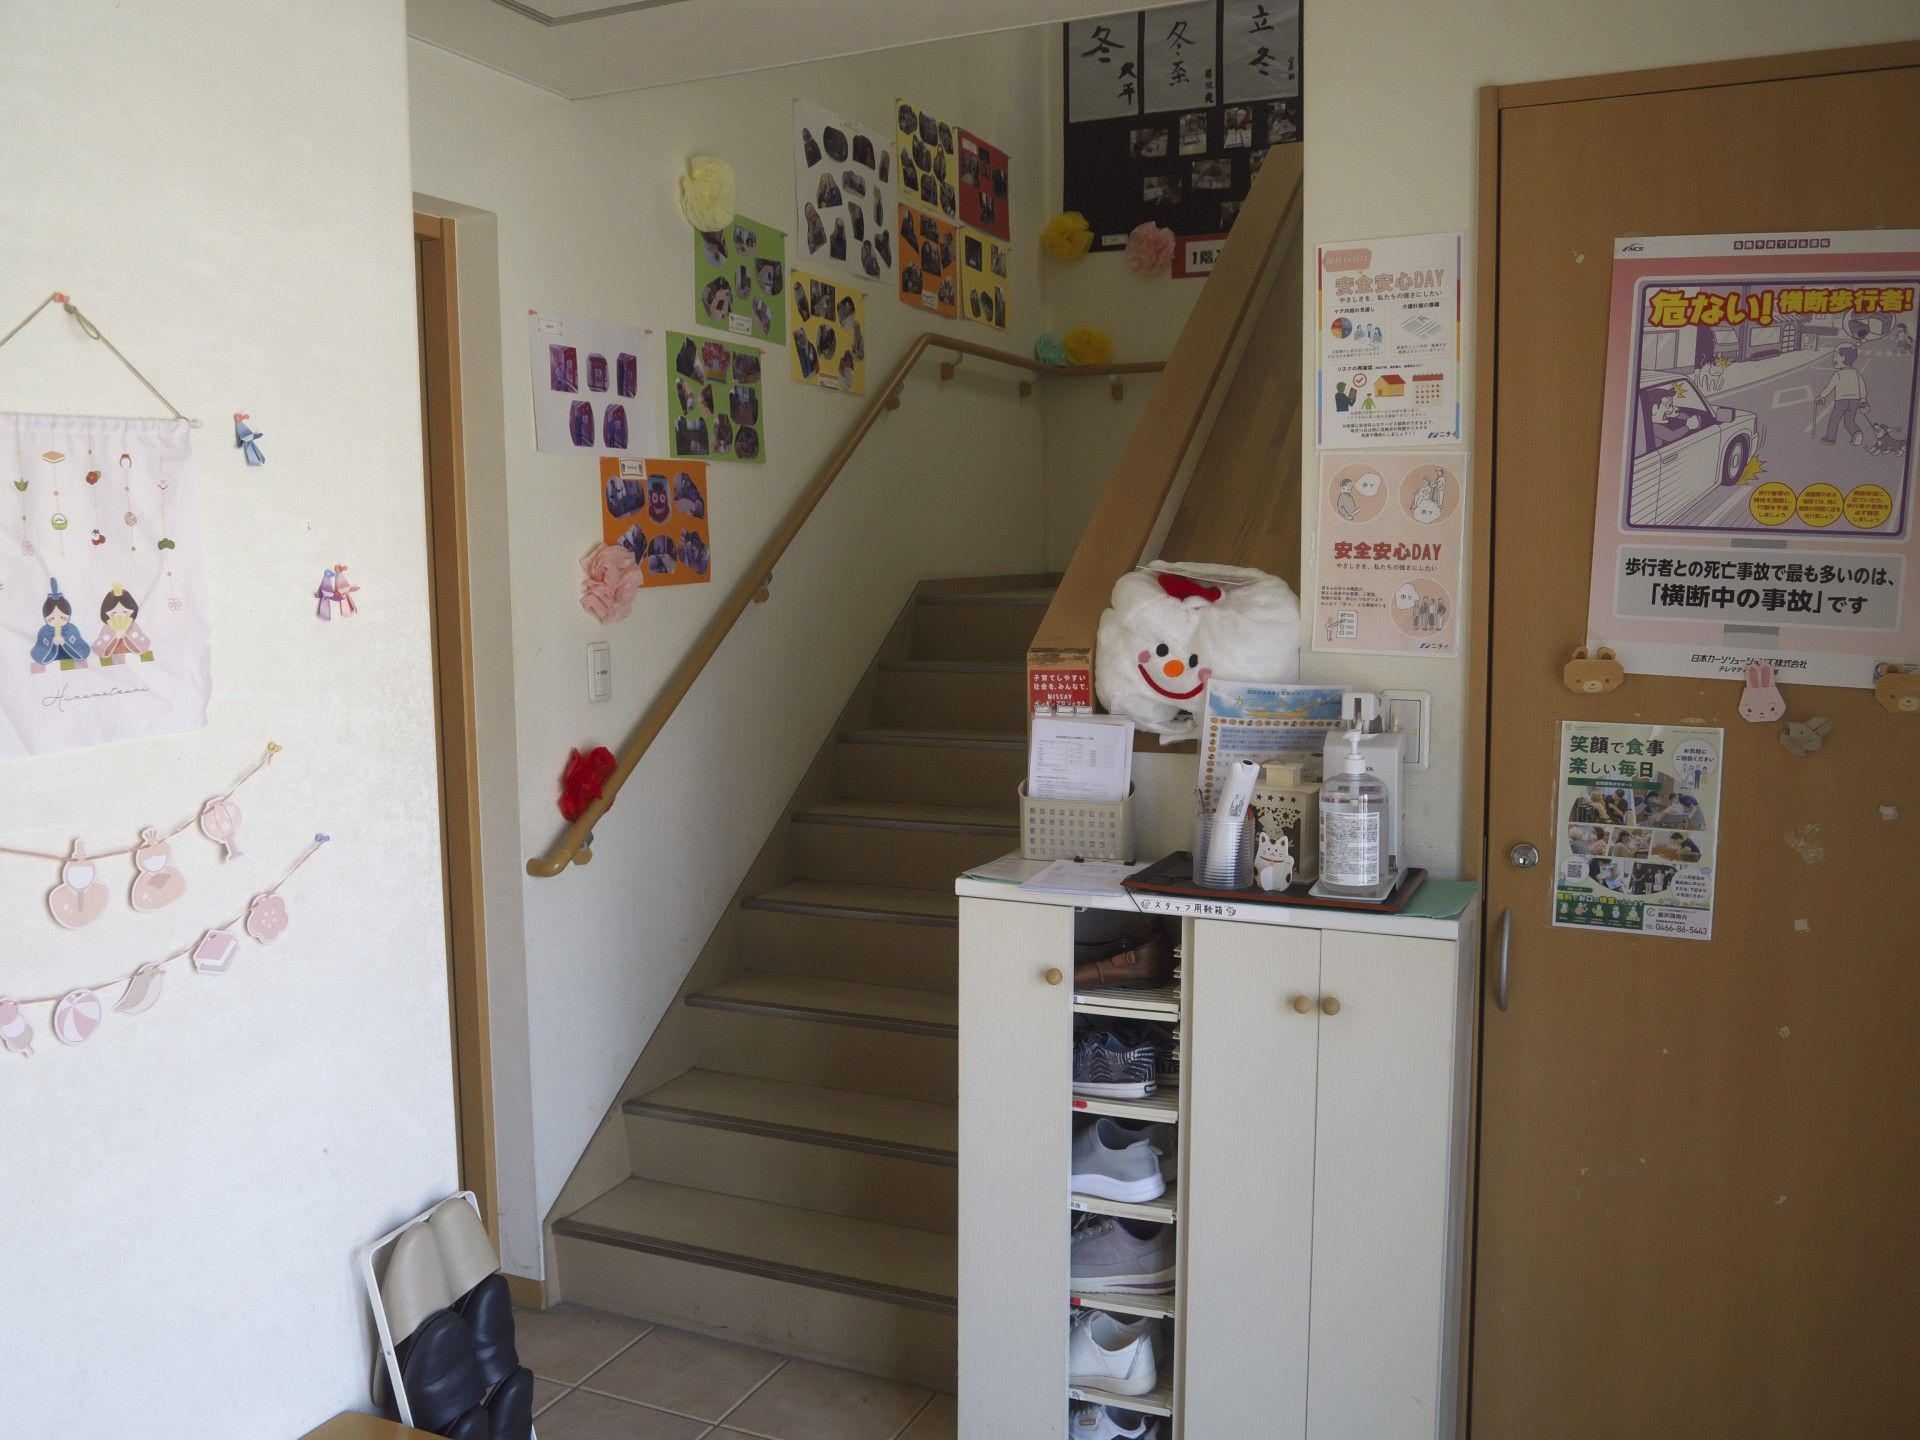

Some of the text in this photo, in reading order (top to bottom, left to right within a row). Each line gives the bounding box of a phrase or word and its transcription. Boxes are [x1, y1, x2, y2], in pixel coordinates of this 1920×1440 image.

[1081, 25, 1126, 63] 冬
[1249, 4, 1276, 76] 立冬
[1334, 268, 1445, 297] 安全安心DAY
[1648, 289, 1774, 328] 危ない！
[1777, 287, 1915, 315] 横断歩行者！
[1334, 541, 1442, 561] 安全安心DAY
[1625, 557, 1895, 586] 歩行者との死亡事故で最も多いのは、
[1651, 582, 1868, 614] 「横断中の事故」です
[1033, 674, 1086, 683] 子育てしやすい
[1570, 735, 1665, 757] 笑顔で食事
[1569, 756, 1654, 778] 楽しい毎日
[1153, 901, 1224, 916] スタッフ用靴箱
